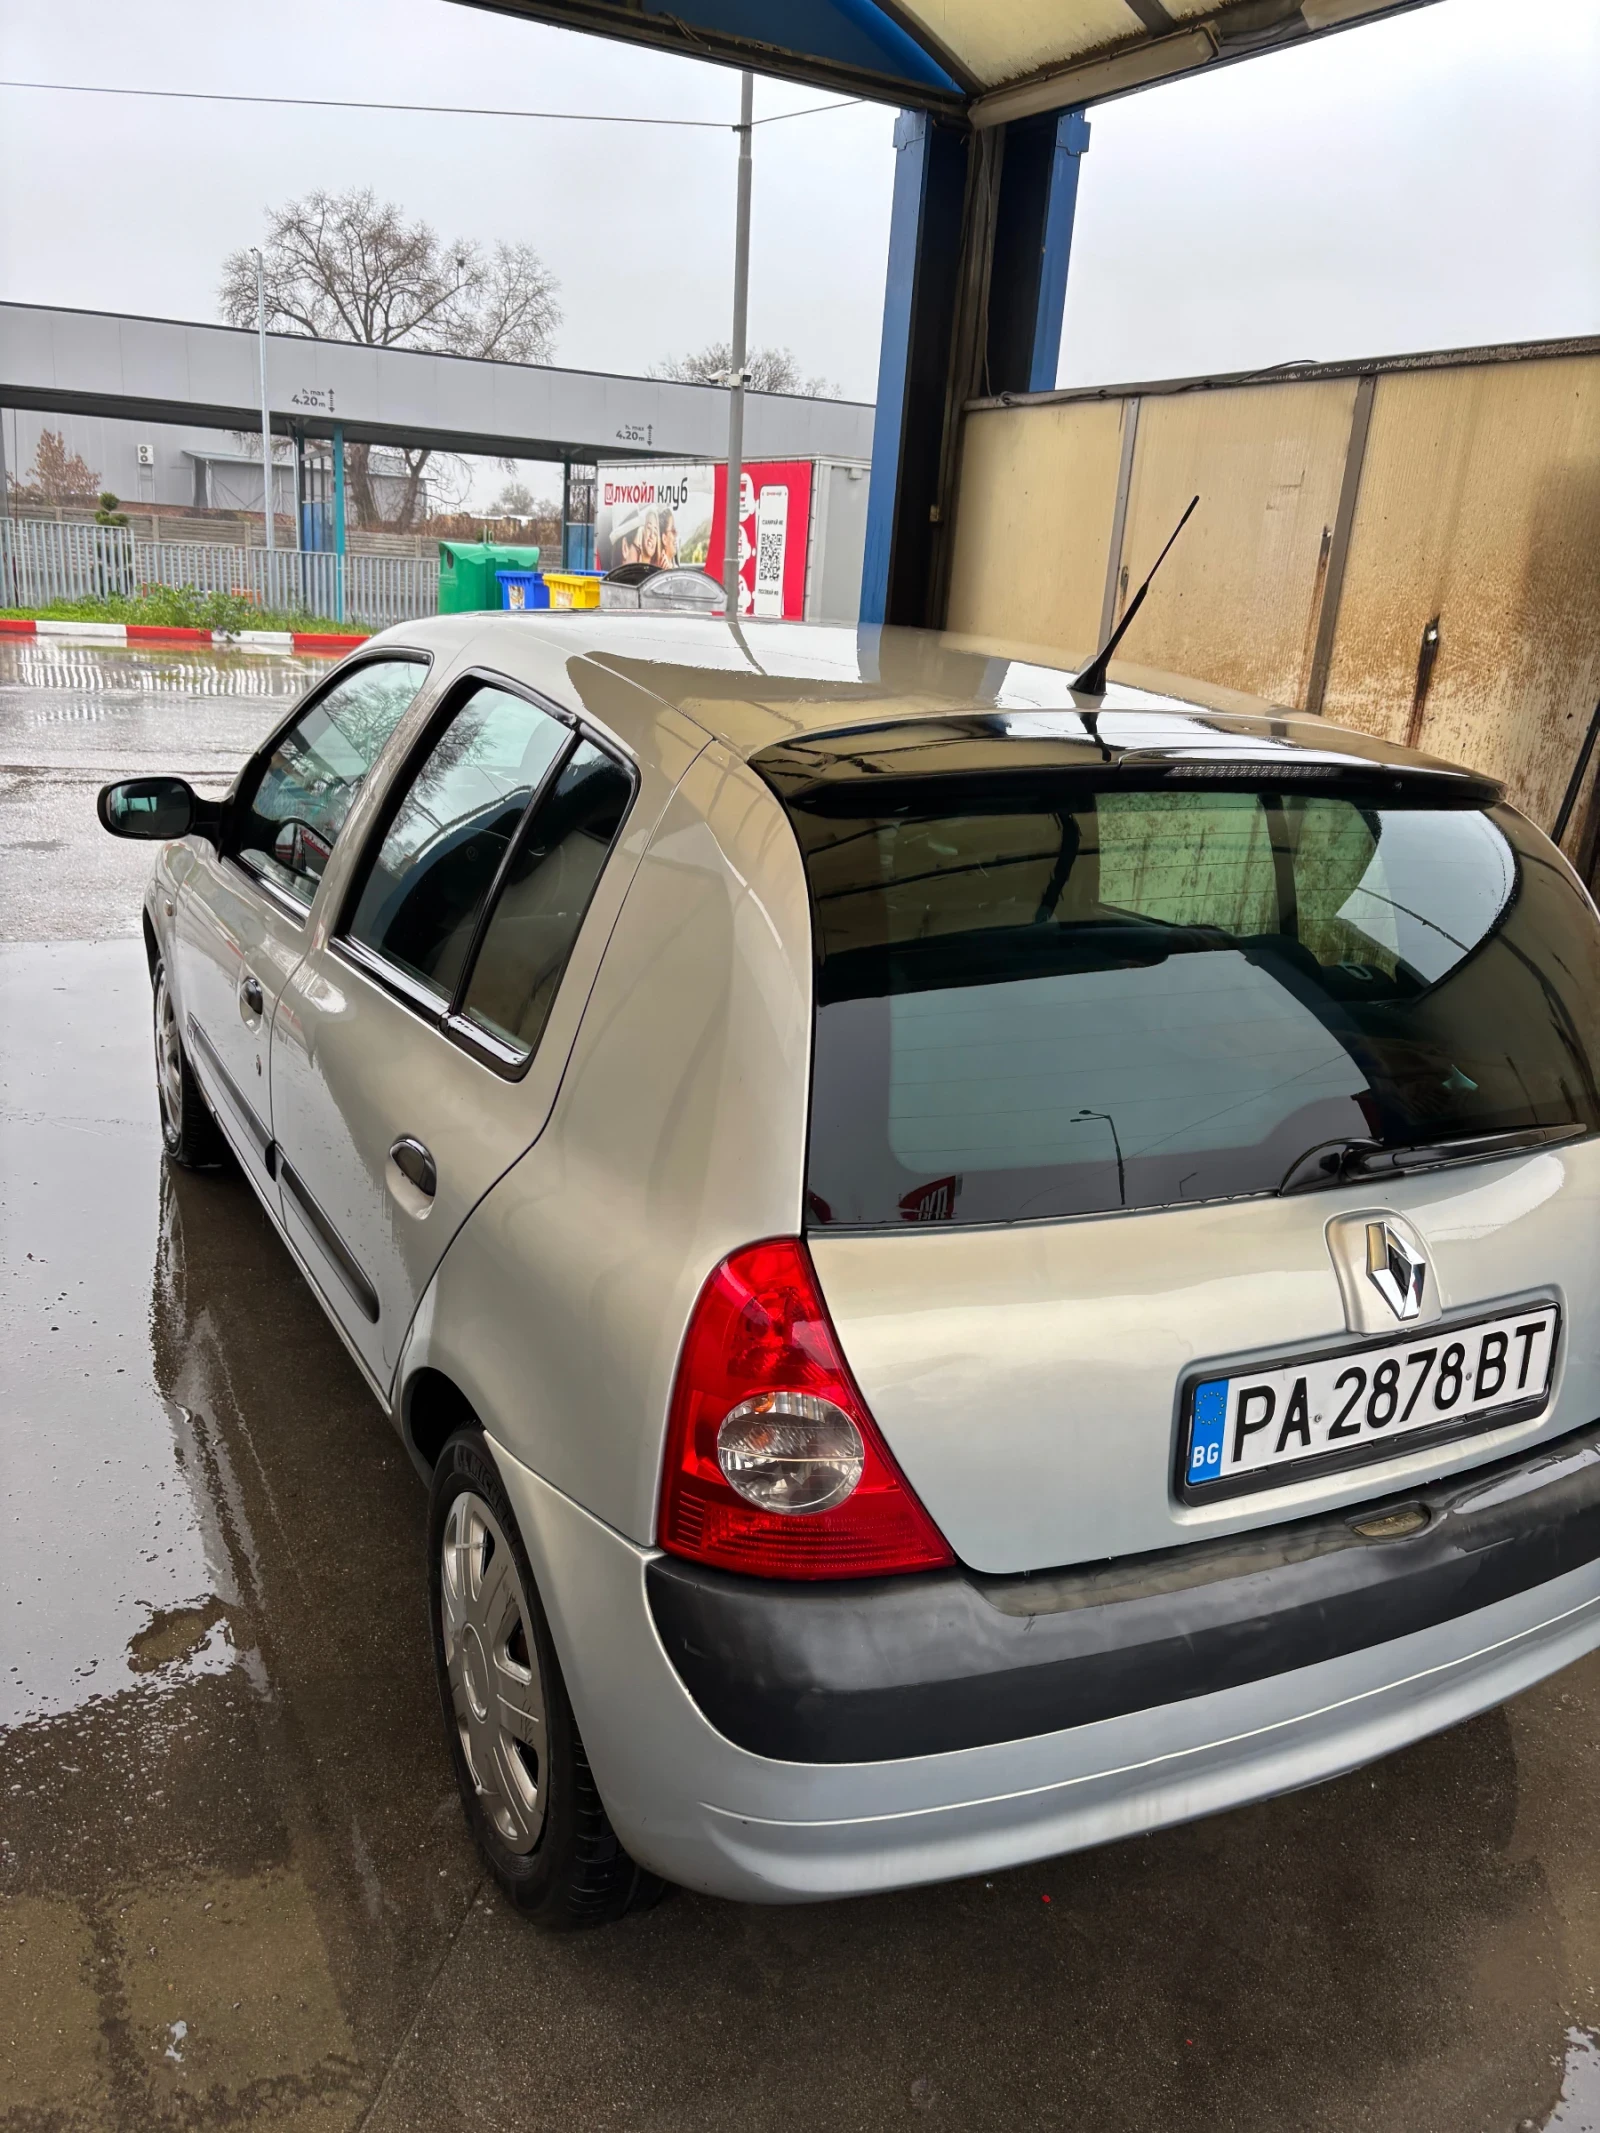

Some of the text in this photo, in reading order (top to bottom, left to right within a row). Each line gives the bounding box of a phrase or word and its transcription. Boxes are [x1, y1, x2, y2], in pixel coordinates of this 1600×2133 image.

[614, 477, 689, 511] ЛУКОЙЛ клуб
[1232, 1321, 1547, 1463] PA 2878 BT
[1191, 1441, 1219, 1469] BG
